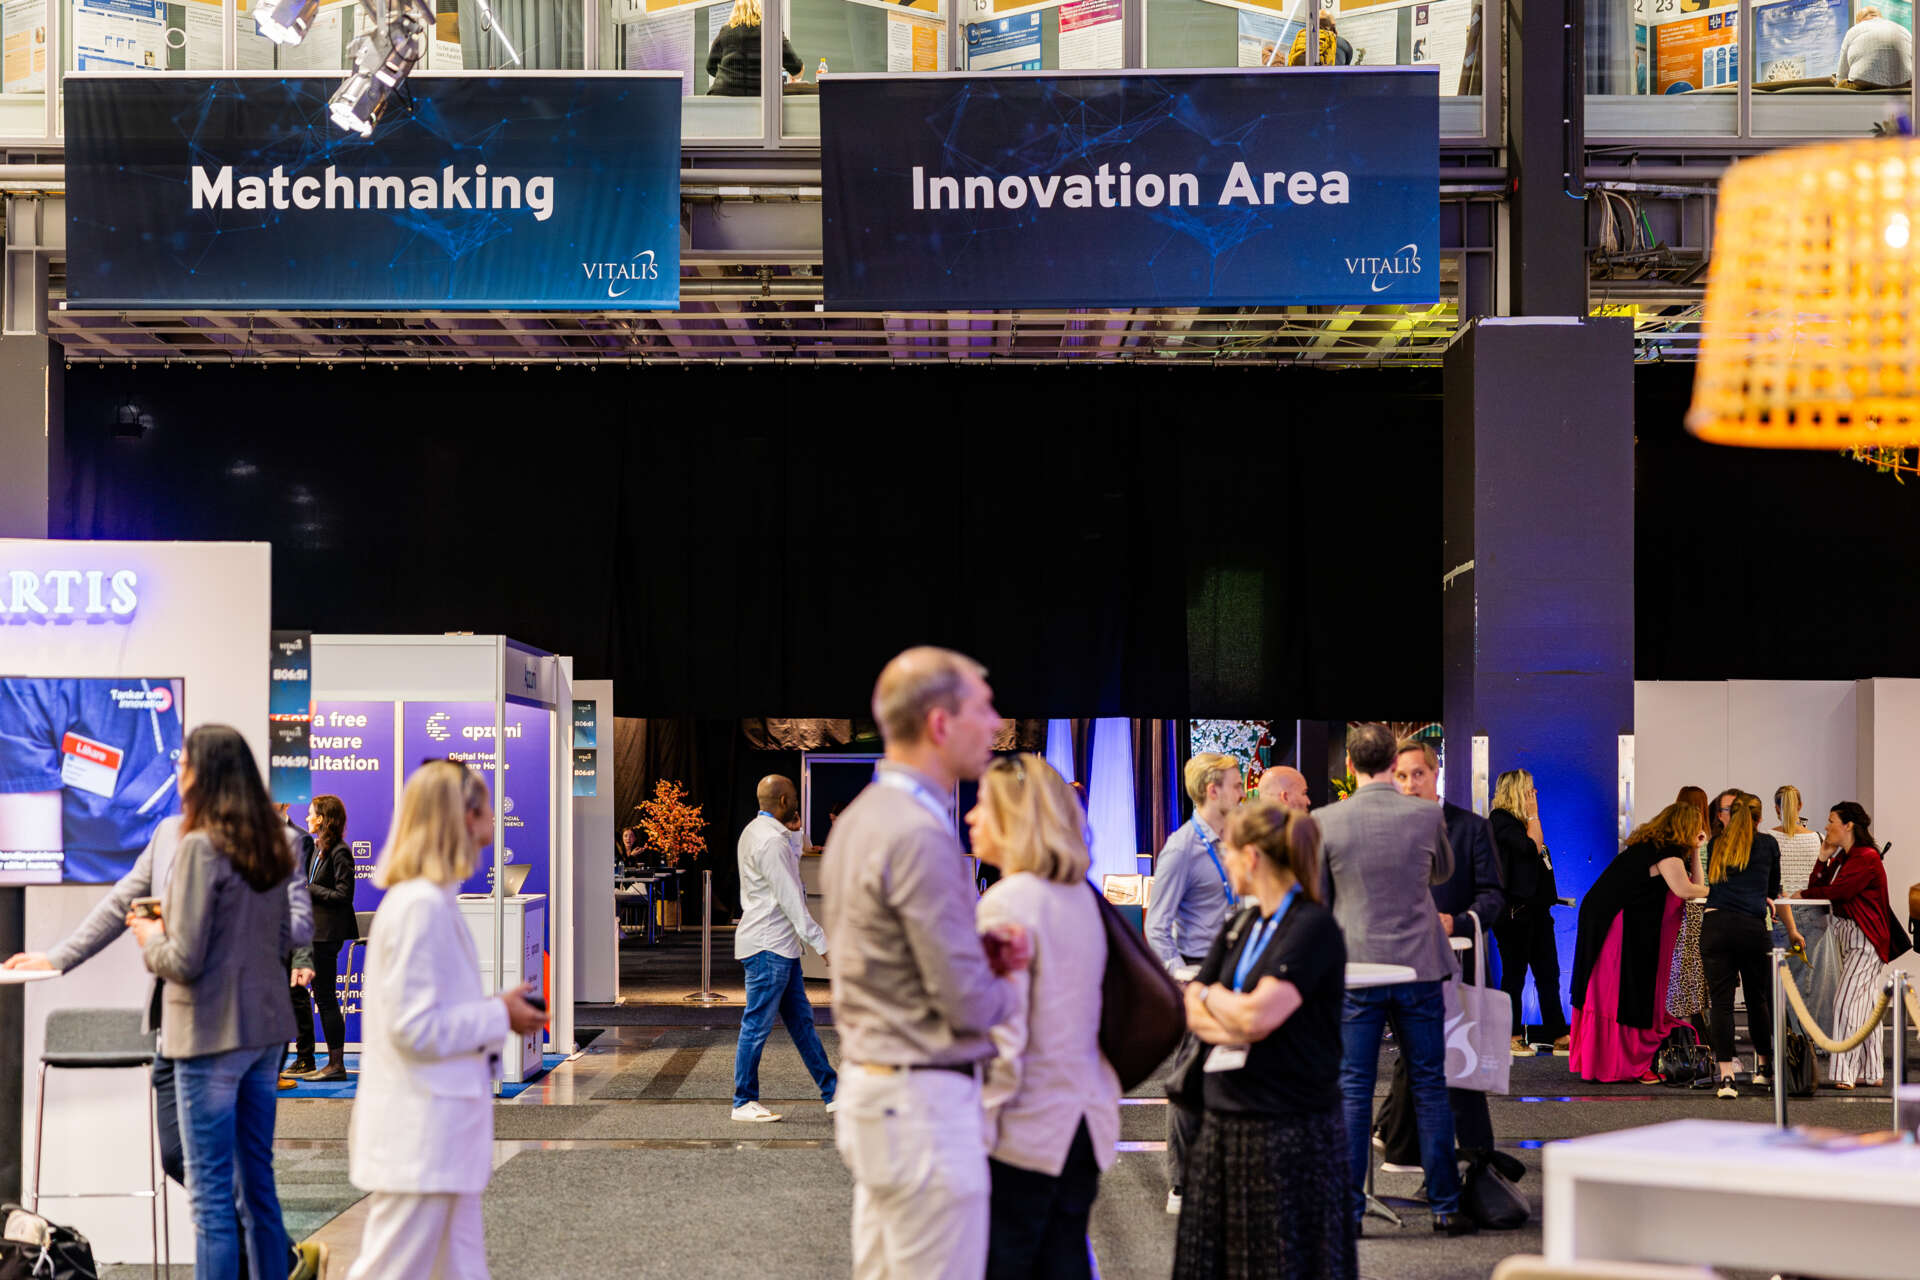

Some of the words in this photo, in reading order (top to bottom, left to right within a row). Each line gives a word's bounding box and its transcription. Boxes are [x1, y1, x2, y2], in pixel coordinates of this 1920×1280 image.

[1655, 0, 1674, 13] 23
[191, 163, 555, 222] Matchmaking
[912, 162, 1199, 210] Innovation
[1218, 161, 1350, 206] Area
[581, 262, 659, 280] VITALIS
[1343, 256, 1422, 275] VITALIS
[313, 714, 325, 728] a
[329, 711, 368, 728] free
[309, 734, 363, 749] tware
[308, 753, 380, 771] ultation
